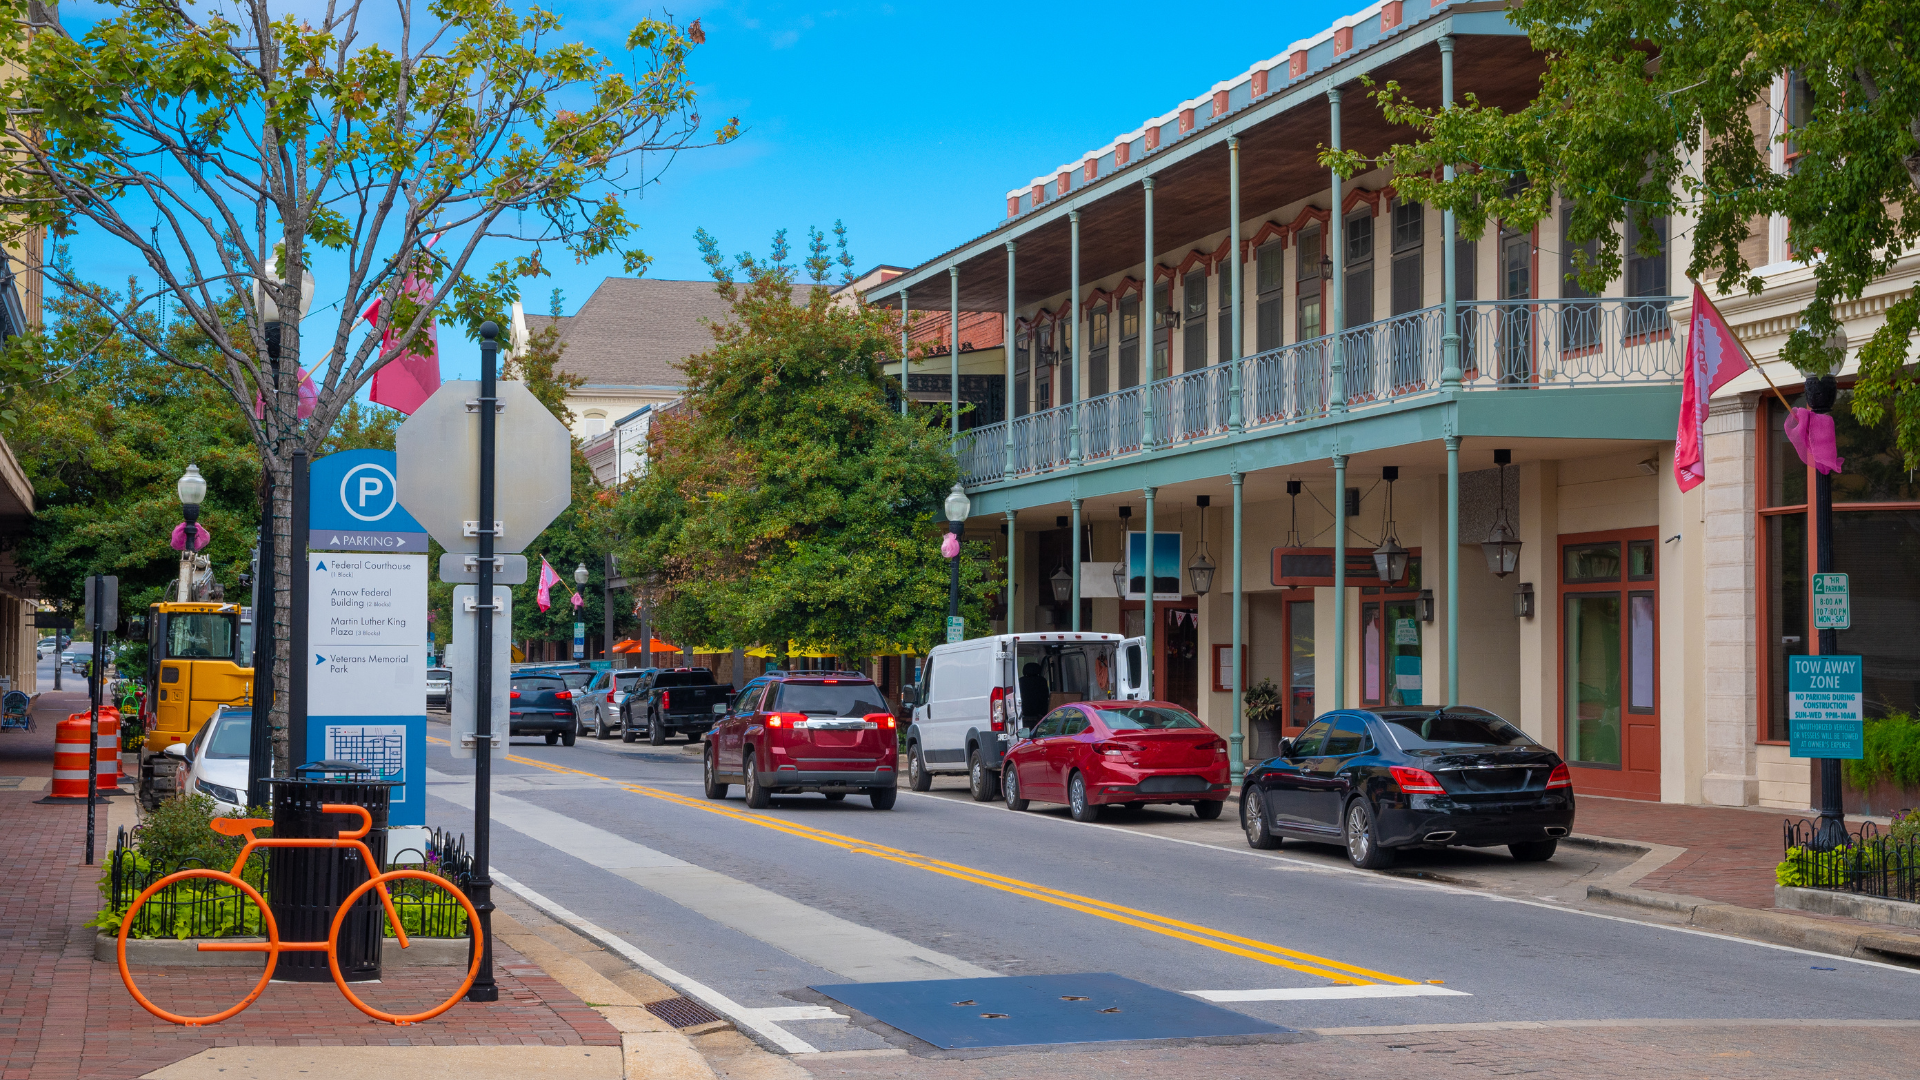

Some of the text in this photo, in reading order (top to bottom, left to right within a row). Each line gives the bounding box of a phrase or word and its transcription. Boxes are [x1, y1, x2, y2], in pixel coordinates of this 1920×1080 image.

[359, 477, 383, 507] P
[343, 535, 393, 547] PARKING
[331, 560, 411, 570] Federal Courthouse
[1815, 578, 1822, 591] 2
[330, 588, 392, 596] Arnow Federal
[331, 598, 364, 609] Building
[330, 617, 406, 628] Martin Luther King
[330, 627, 354, 636] Plaza
[330, 655, 409, 663] Veterans Memorial
[330, 665, 348, 673] Park
[1795, 661, 1856, 674] TOW AWAY
[1810, 675, 1840, 689] ZONE
[1806, 693, 1831, 701] PARKING
[1795, 711, 1822, 719] SUN-WED
[1797, 723, 1855, 731] UNAUTHORIZED VEHICLES
[1793, 731, 1802, 739] OR
[1842, 732, 1858, 740] TOWED
[1800, 740, 1807, 748] AT
[1831, 741, 1851, 749] EXPENSE
